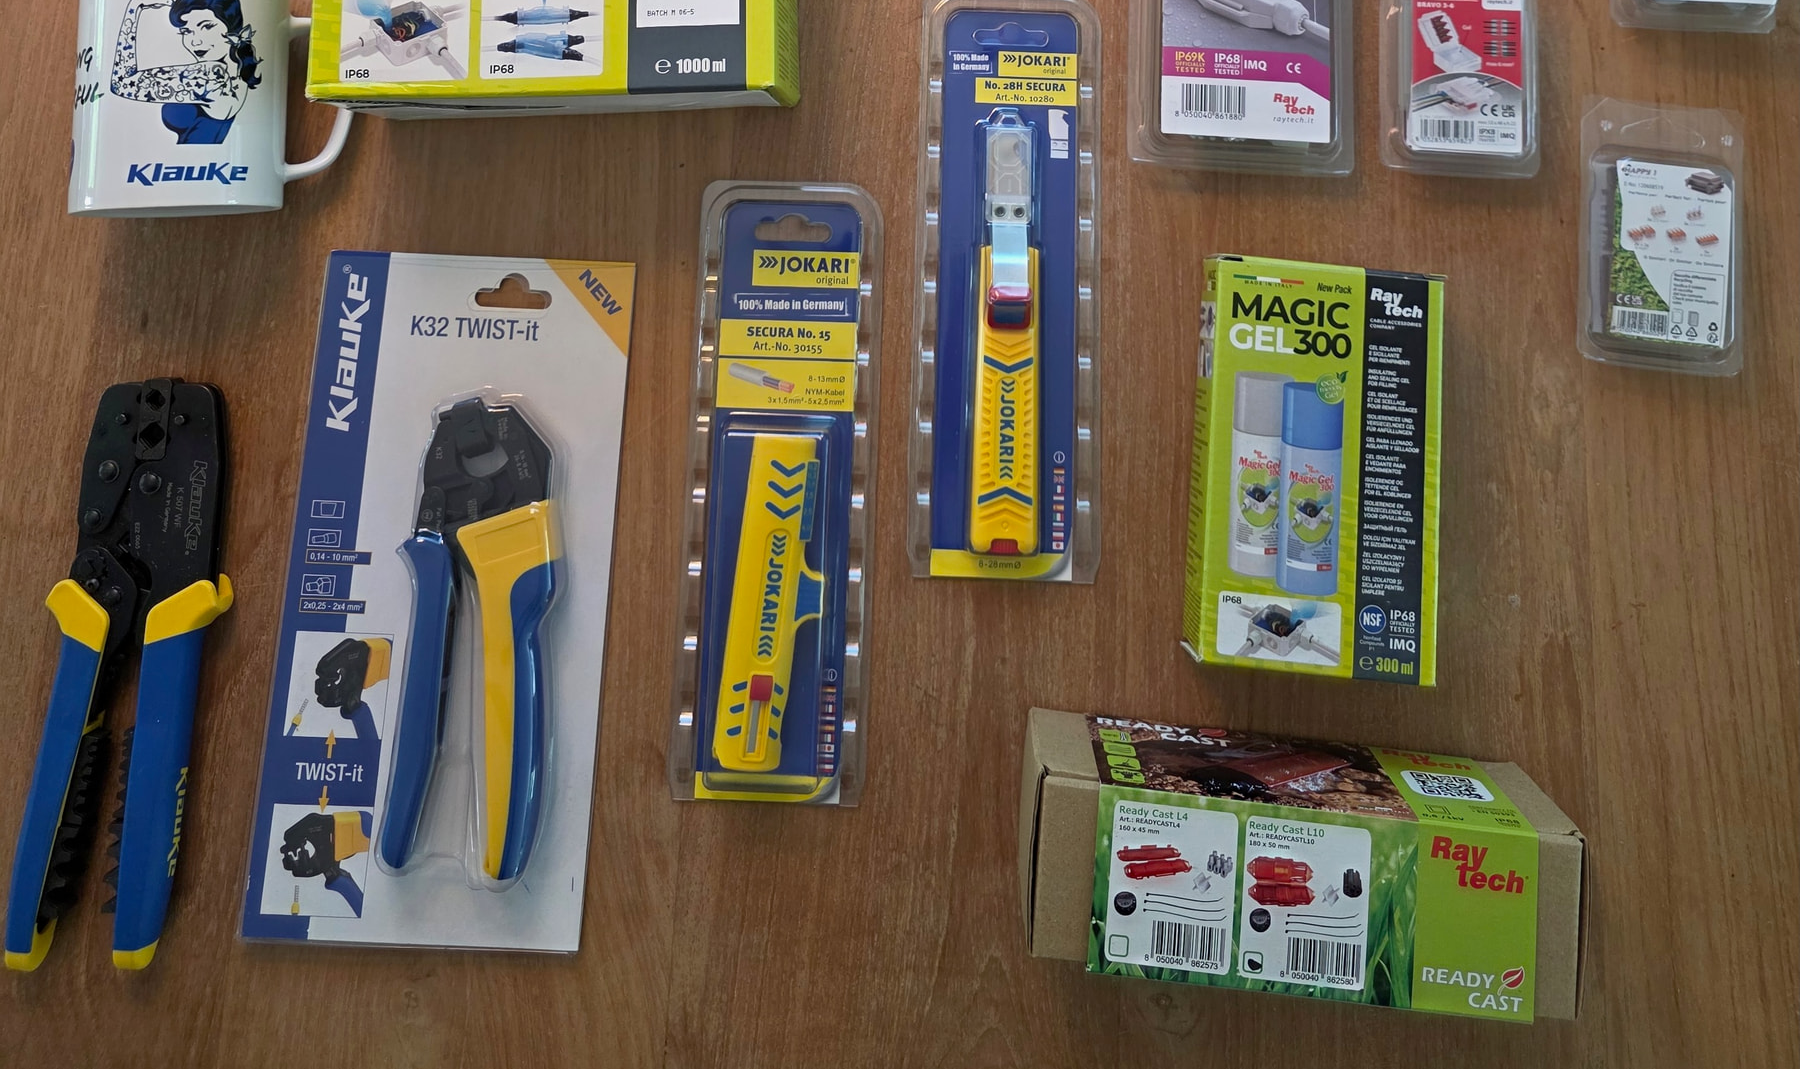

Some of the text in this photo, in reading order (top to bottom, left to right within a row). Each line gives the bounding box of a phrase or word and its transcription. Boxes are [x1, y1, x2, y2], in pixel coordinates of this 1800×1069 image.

[676, 58, 726, 74] 1000 ml
[1017, 55, 1067, 67] JOKARI
[1175, 51, 1267, 71] IP69K IP68 IMQ
[345, 68, 370, 79] IP68
[489, 64, 514, 74] IP68
[1043, 67, 1067, 75] original
[984, 80, 1066, 92] No. 28H SECURA
[995, 94, 1054, 103] Art.-No. 10280
[1273, 93, 1298, 108] Ray
[1273, 116, 1314, 124] raytech.it
[779, 256, 849, 275] JOKARI
[816, 276, 849, 286] original
[1317, 282, 1352, 295] New Pack
[578, 269, 622, 316] NEW
[1370, 287, 1403, 308] Ray
[738, 299, 844, 312] 100% Made in Germany
[1231, 291, 1350, 330] MAGIC
[410, 316, 540, 342] K32 TWIST-it
[746, 326, 830, 341] SECURA No. 15
[753, 341, 822, 354] Art.-No. 30155
[805, 388, 845, 396] NYM-Kabel
[999, 394, 1015, 466] JOKARI
[310, 552, 324, 561] 0,14
[335, 553, 344, 561] 10
[759, 557, 784, 633] JOKARI
[1222, 595, 1242, 604] IP68
[1362, 612, 1383, 626] NSF
[1390, 610, 1416, 621] IP68
[1389, 626, 1415, 634] TESTED
[1389, 638, 1416, 653] IMQ
[1375, 659, 1413, 675] 300 ml
[1096, 717, 1190, 734] READY
[1161, 732, 1231, 747] CAST
[295, 762, 364, 782] TWIST-it
[1119, 805, 1189, 821] Ready Cast L4
[1119, 815, 1181, 829] Art.: READYCASTL4
[1249, 821, 1325, 838] Ready Cast L10
[1249, 831, 1315, 845] Art.: READYCASTL10
[1430, 835, 1488, 873] Ray
[1144, 953, 1219, 970] 8 050040 862573
[1421, 967, 1495, 989] READY
[1468, 992, 1523, 1013] CAST
